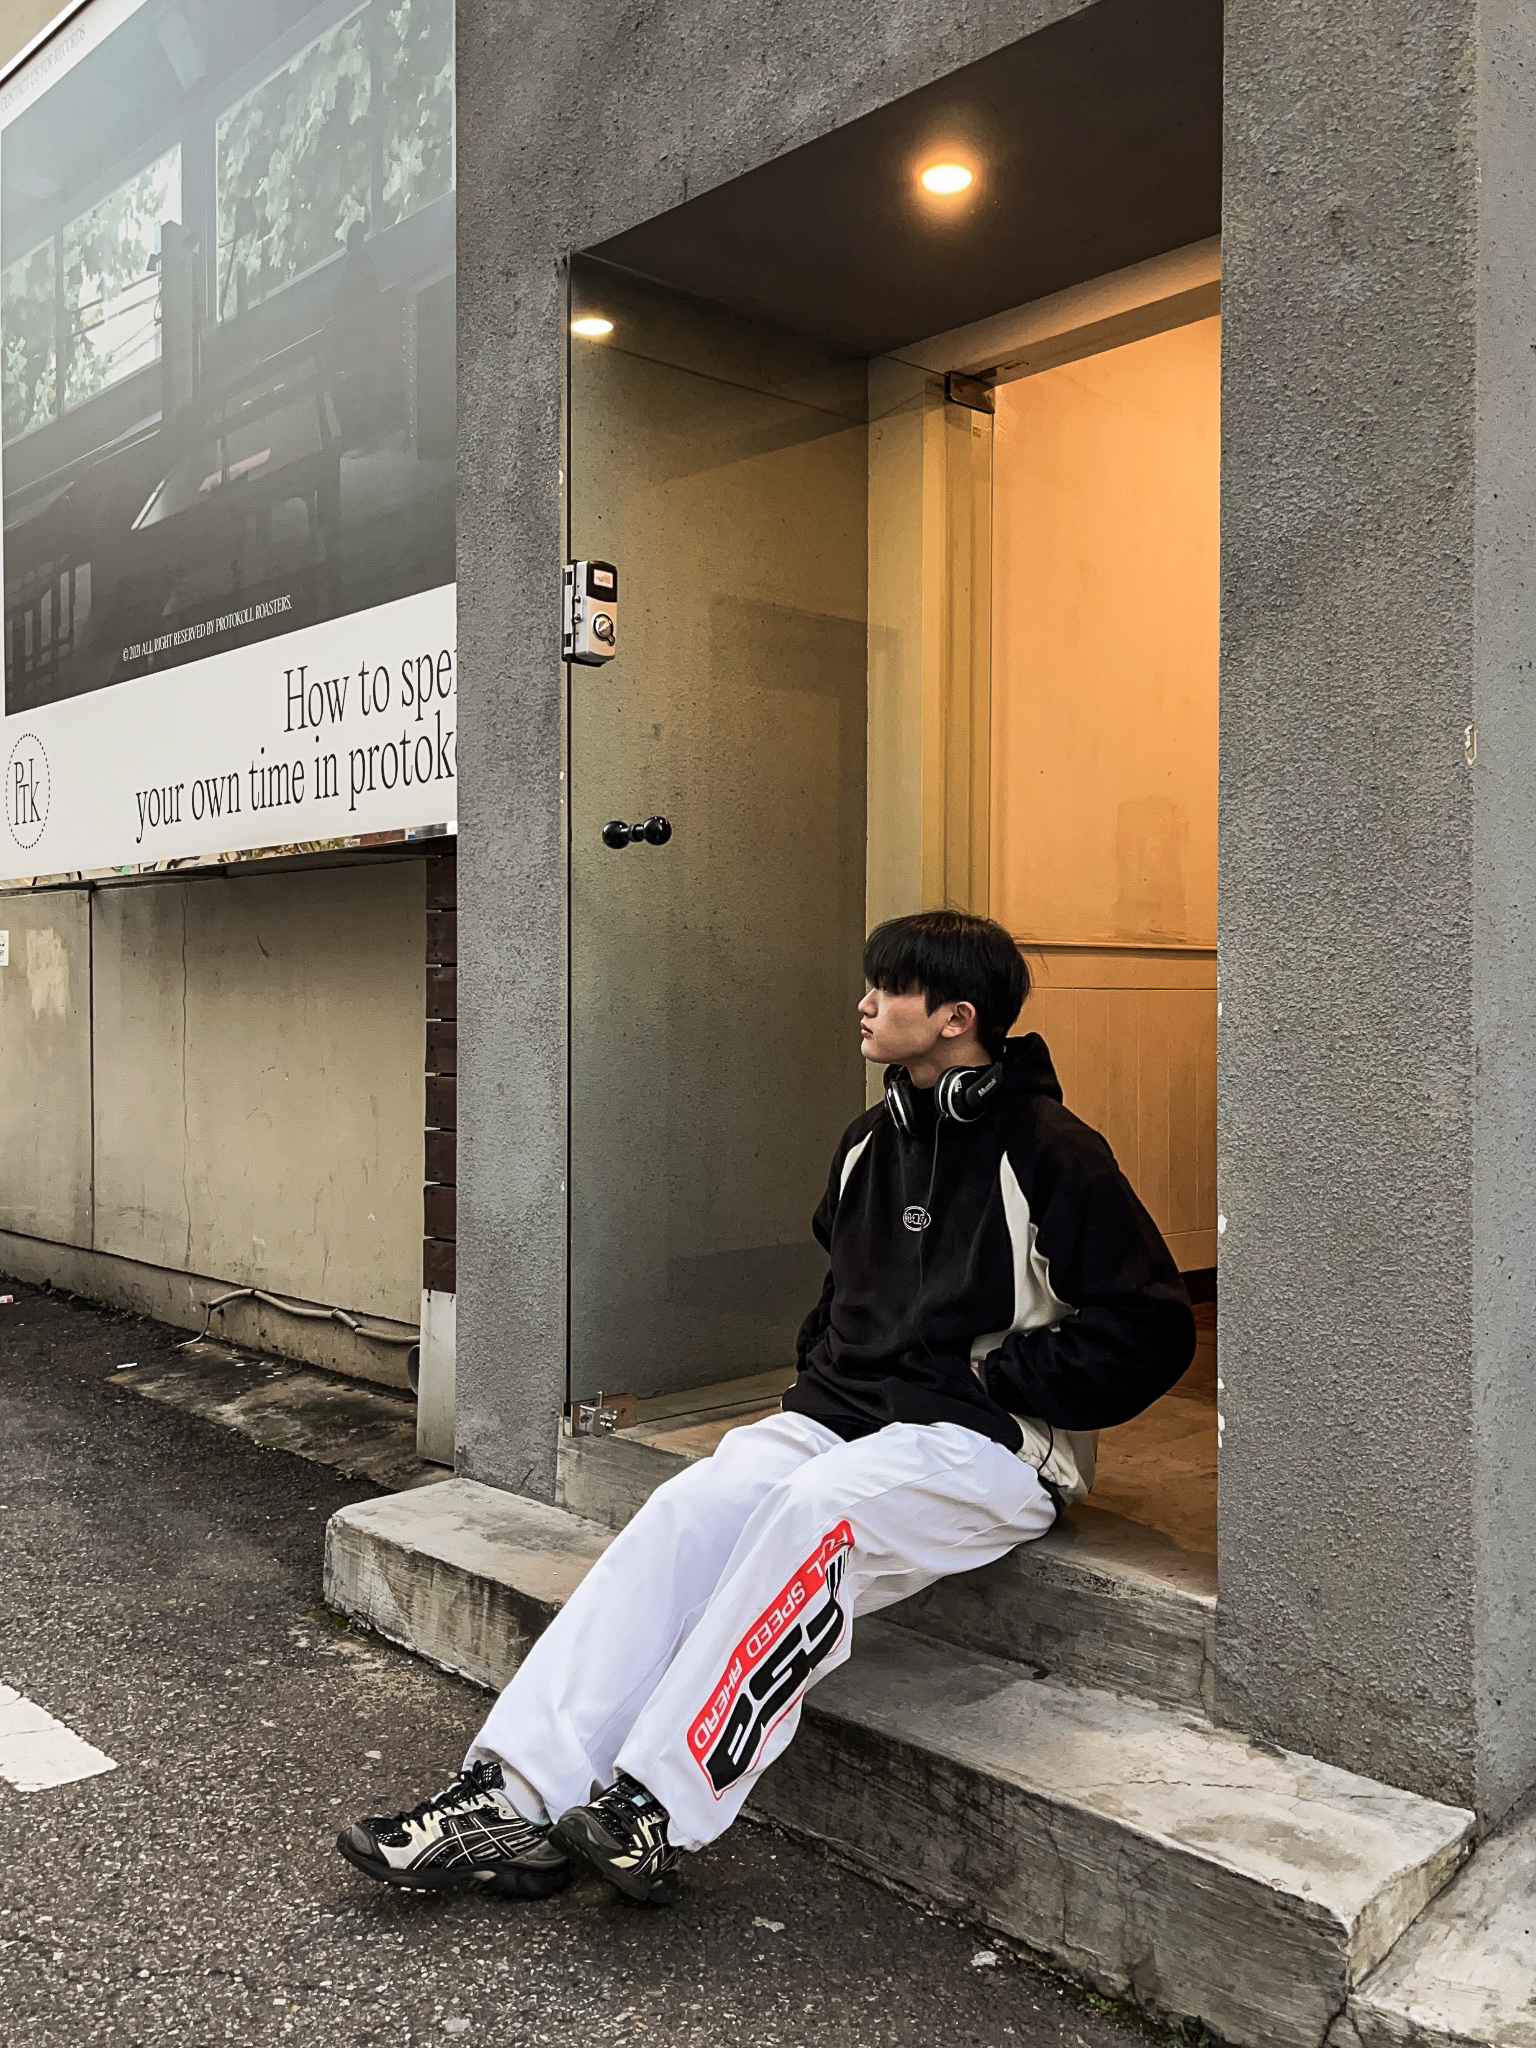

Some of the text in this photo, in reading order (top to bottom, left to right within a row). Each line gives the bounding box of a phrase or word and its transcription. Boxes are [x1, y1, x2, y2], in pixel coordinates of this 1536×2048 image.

[141, 640, 154, 656] ALL
[154, 632, 174, 652] RIGHT
[173, 623, 206, 646] RESERVED
[206, 620, 215, 636] BY
[215, 606, 255, 633] PROTOKOLL
[283, 649, 457, 733] How to spe
[135, 709, 457, 844] your own time in protok
[746, 1580, 806, 1659] SPEED
[694, 1656, 744, 1751] AHEAD
